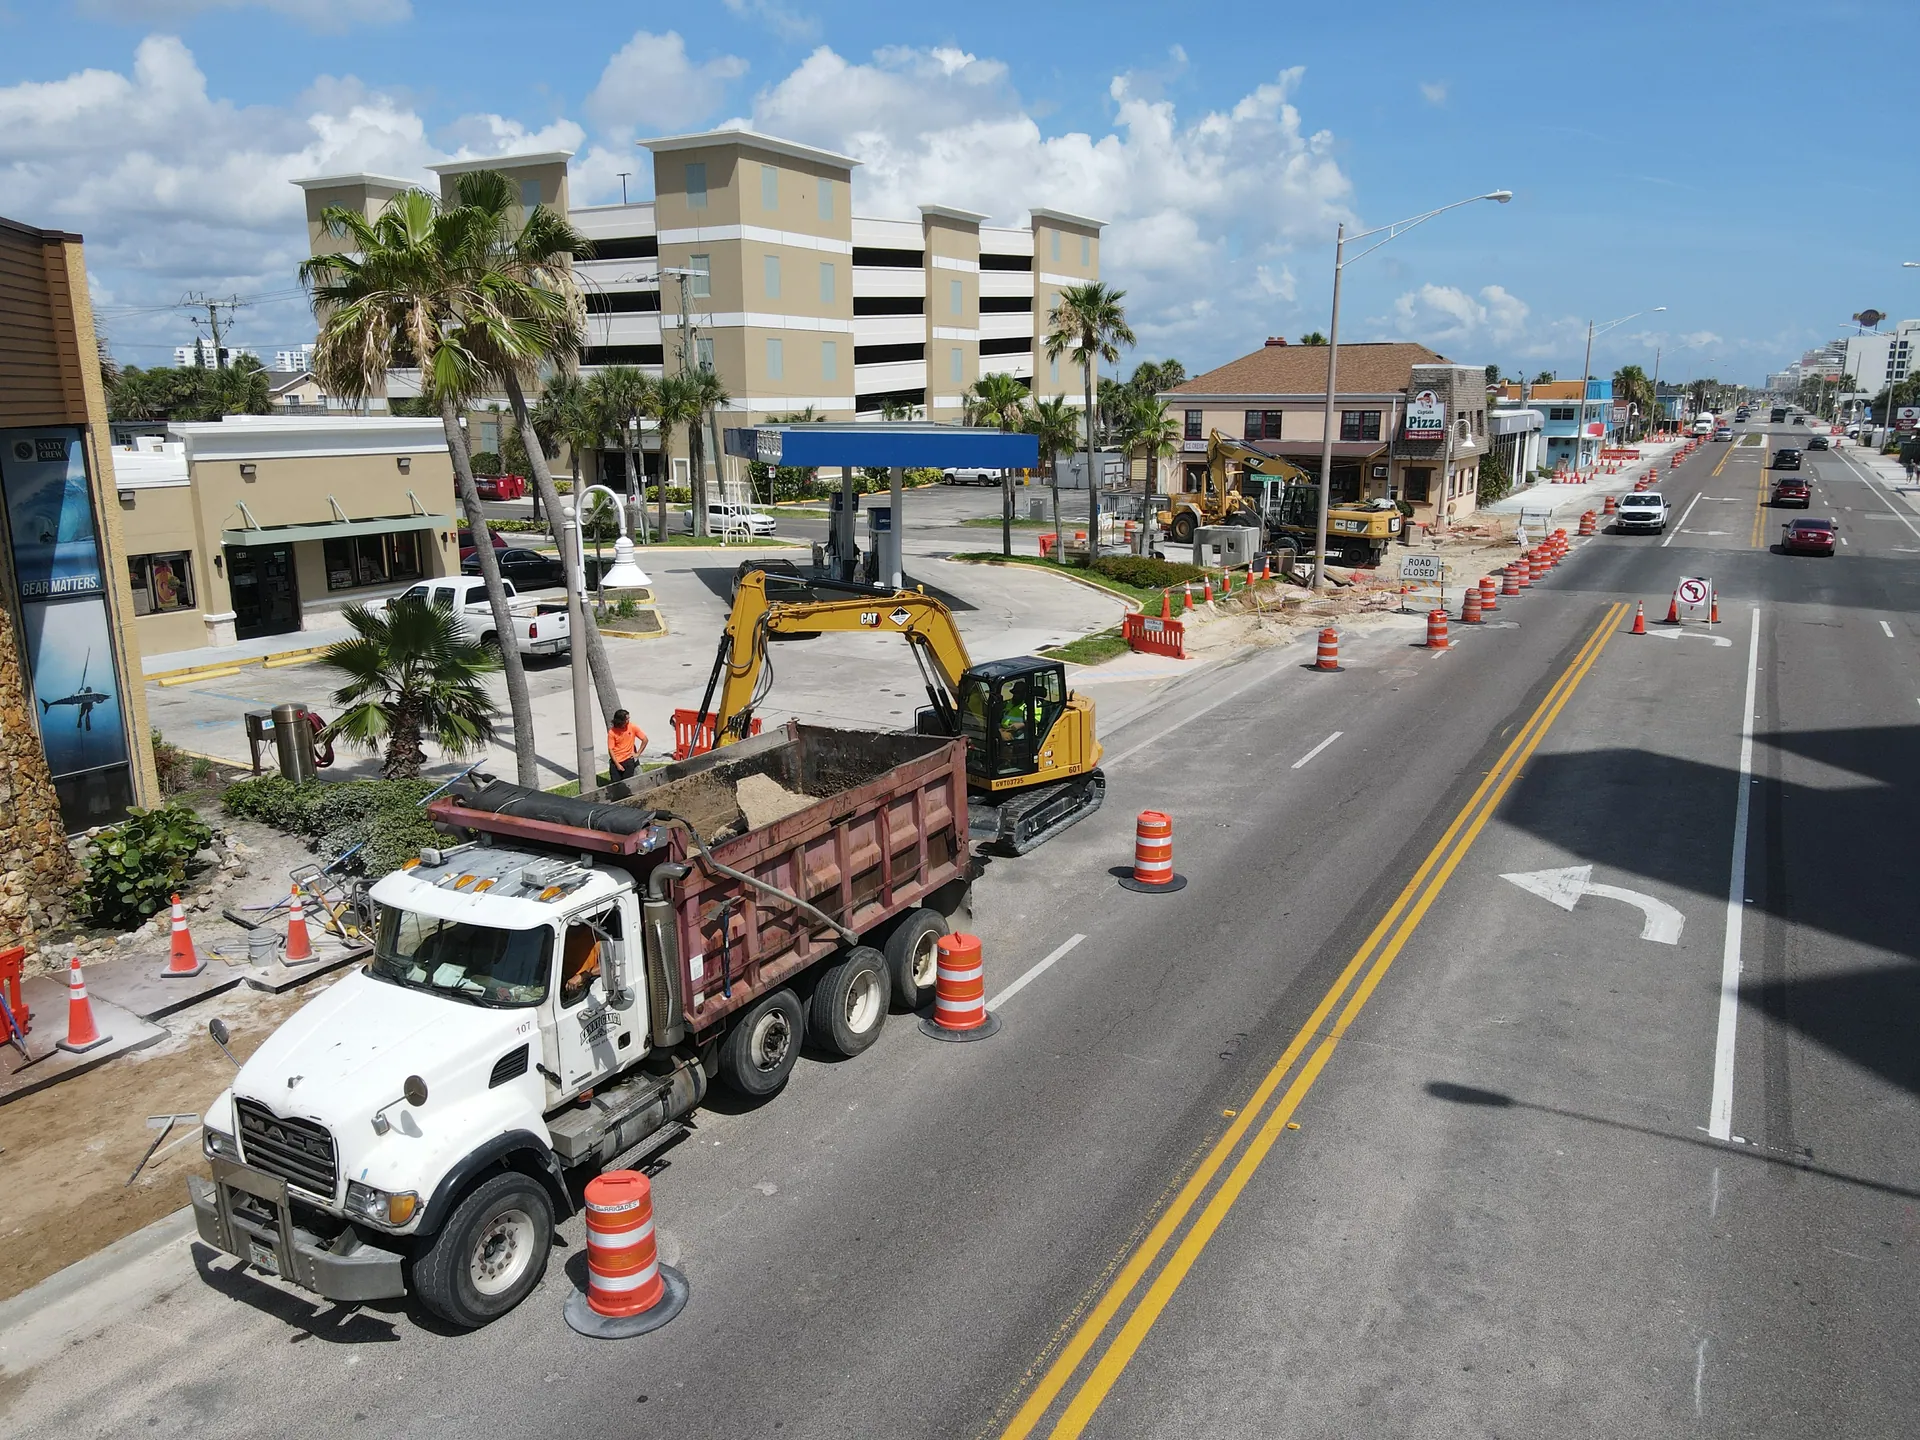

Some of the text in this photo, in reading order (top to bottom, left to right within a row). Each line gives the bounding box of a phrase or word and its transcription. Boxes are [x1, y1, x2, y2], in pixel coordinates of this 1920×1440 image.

[1408, 416, 1442, 428] Pizza
[38, 442, 62, 450] SALTY
[40, 450, 63, 458] CREW
[1408, 558, 1431, 566] ROAD
[1403, 568, 1435, 577] CLOSED
[22, 581, 49, 596] GEAR
[51, 576, 99, 593] MATTERS.
[860, 612, 878, 625] CAT
[1068, 765, 1081, 774] 601
[516, 1020, 531, 1036] 107
[243, 1113, 331, 1160] MACK
